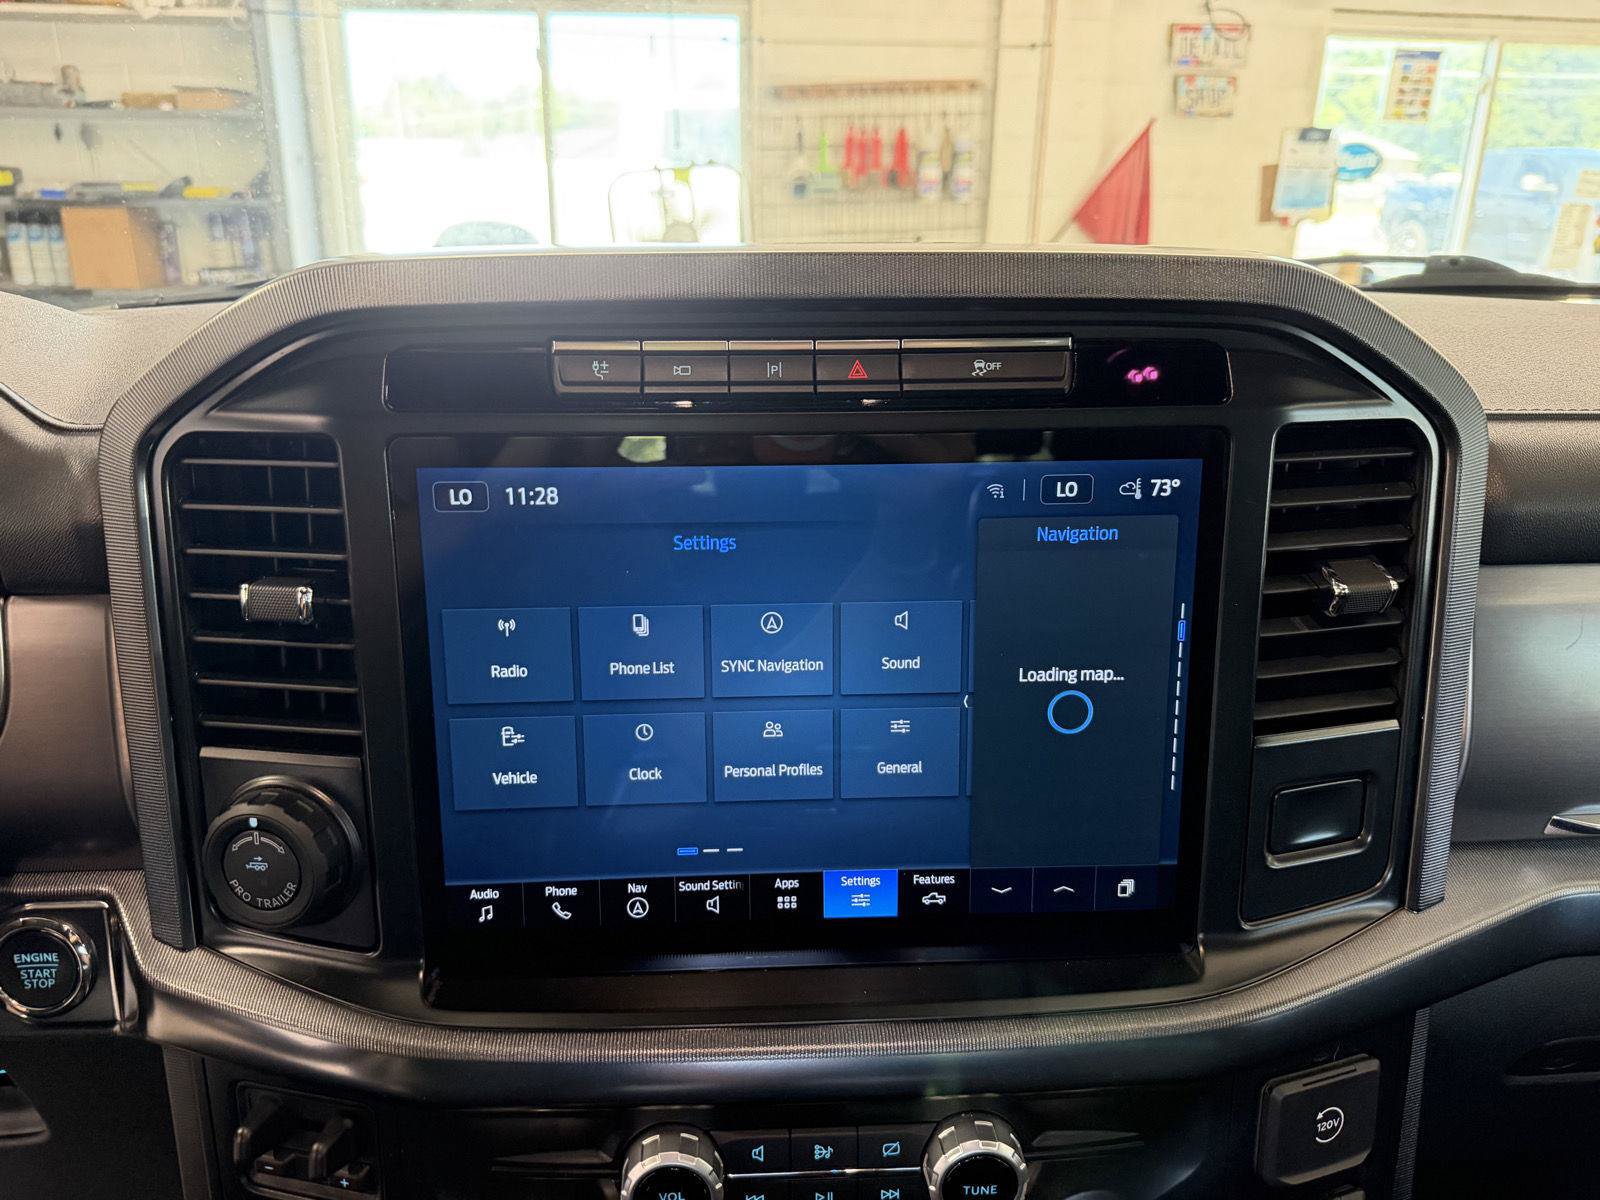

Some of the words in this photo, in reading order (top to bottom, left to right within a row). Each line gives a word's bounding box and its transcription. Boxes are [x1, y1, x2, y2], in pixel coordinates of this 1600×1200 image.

[985, 361, 1002, 371] OFF
[505, 486, 559, 506] 11:28
[1056, 480, 1078, 497] LO
[448, 488, 473, 506] LO
[1036, 525, 1119, 544] Navigation
[673, 535, 737, 553] Settings
[609, 661, 649, 676] Phone
[650, 660, 675, 675] List
[720, 659, 755, 673] SYNC
[757, 657, 823, 675] Navigation
[881, 655, 920, 670] Sound
[490, 664, 528, 679] Radio
[1018, 666, 1077, 685] Loading
[1080, 666, 1125, 684] map...
[628, 767, 663, 781] Clock
[724, 764, 776, 779] Personal
[778, 762, 823, 777] Profiles
[876, 760, 922, 775] General
[492, 771, 538, 786] Vehicle
[678, 880, 710, 892] Sound
[712, 879, 744, 891] Settin
[774, 877, 799, 890] Apps
[840, 875, 881, 888] Settings
[913, 873, 955, 885] Features
[228, 879, 252, 902] PRO
[256, 881, 297, 909] TRAILER
[469, 888, 499, 901] Audio
[545, 884, 577, 898] Phone
[627, 882, 648, 894] Nav
[13, 951, 60, 965] ENGINE
[20, 968, 57, 980] START
[23, 976, 56, 989] STOP
[1316, 1116, 1340, 1132] 120V
[658, 1191, 686, 1200] VOL
[962, 1183, 998, 1196] TUNE
